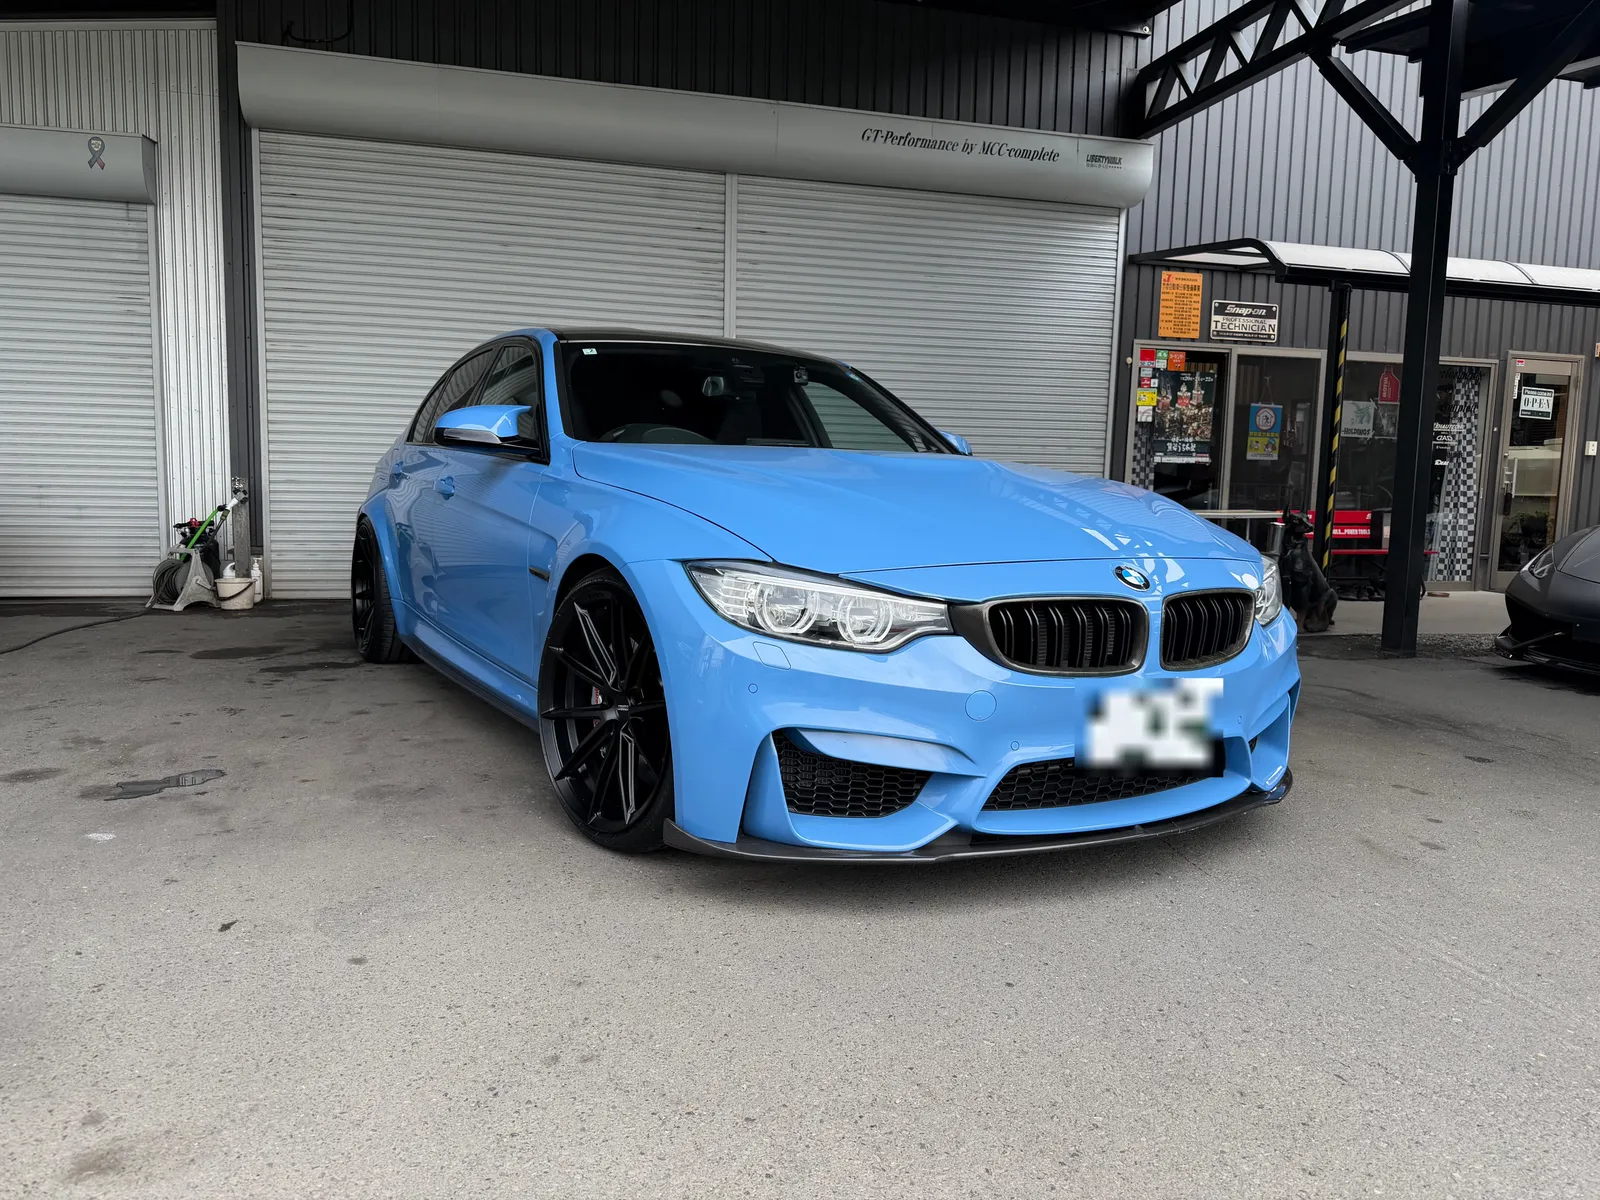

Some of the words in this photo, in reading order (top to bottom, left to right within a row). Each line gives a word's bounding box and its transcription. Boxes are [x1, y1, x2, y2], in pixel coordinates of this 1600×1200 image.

[861, 128, 959, 152] GT-Performance
[961, 138, 978, 155] by
[978, 141, 1060, 162] MCC-complete
[1224, 304, 1266, 316] Snap-on
[1213, 320, 1276, 333] TECHNICIAN
[1222, 317, 1267, 325] PROFESSIONAL
